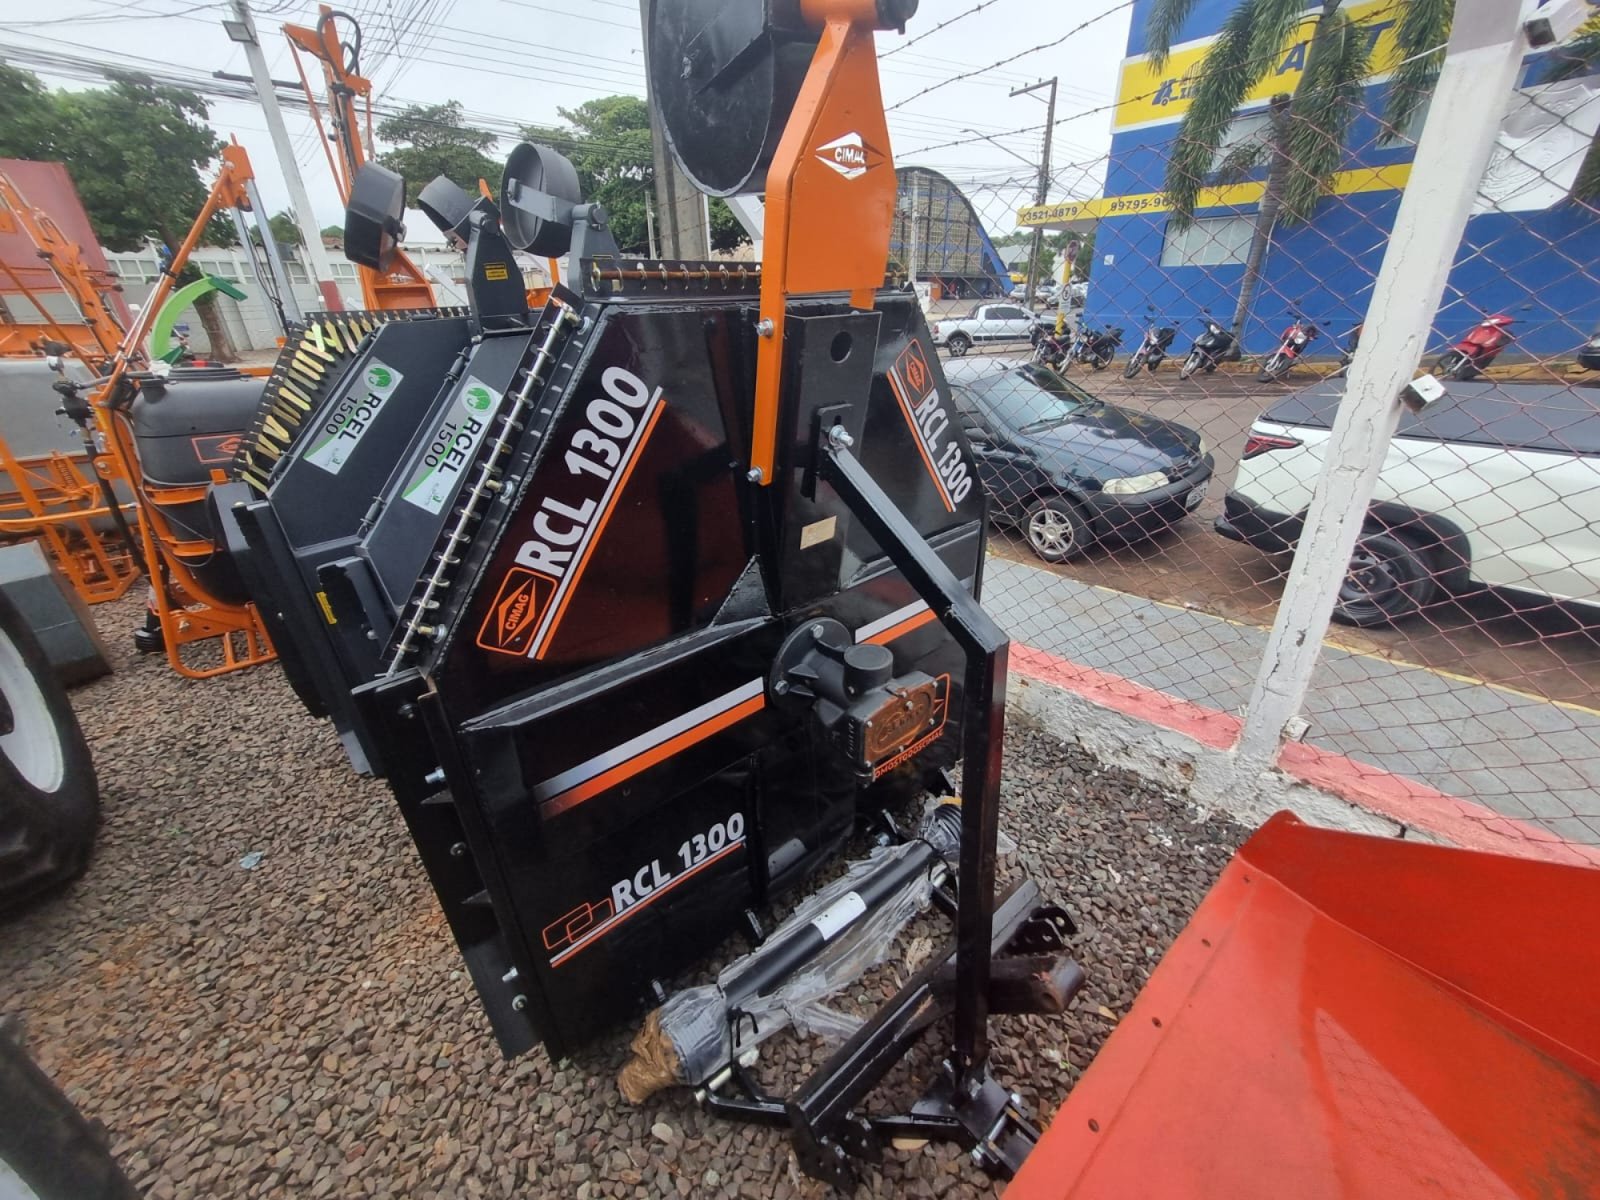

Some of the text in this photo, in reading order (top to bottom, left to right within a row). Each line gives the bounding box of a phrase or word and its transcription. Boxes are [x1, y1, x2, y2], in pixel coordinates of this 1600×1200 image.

[325, 395, 358, 436] 1500
[337, 391, 383, 441] RCEL
[423, 421, 458, 468] 1500
[437, 416, 484, 474] RCEL
[514, 365, 650, 578] RCL 1300
[914, 388, 973, 504] RCL 1300
[611, 811, 745, 914] RCL 1300
